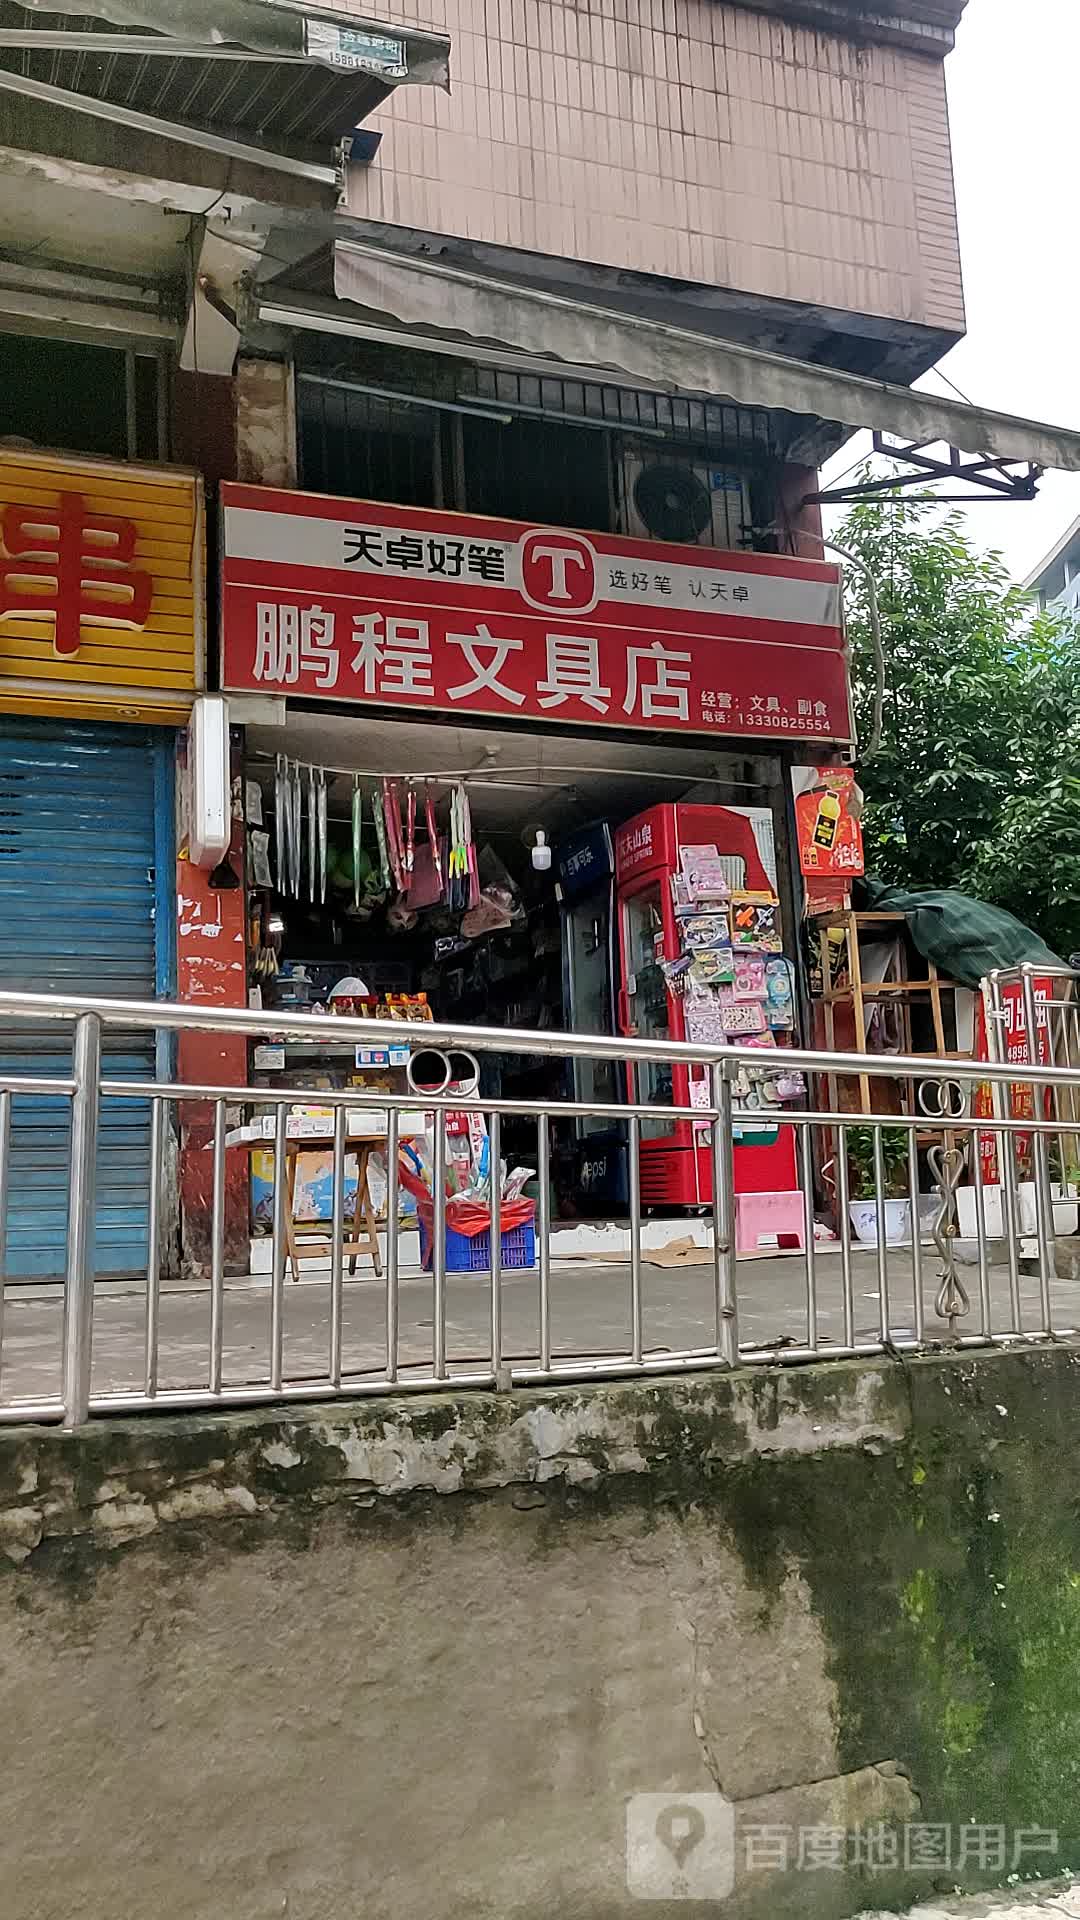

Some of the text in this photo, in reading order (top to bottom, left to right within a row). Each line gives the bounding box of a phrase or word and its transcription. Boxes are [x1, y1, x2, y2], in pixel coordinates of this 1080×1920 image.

[0, 492, 153, 657] 串
[343, 528, 505, 582] 天卓好笔
[531, 545, 585, 599] T
[609, 569, 749, 602] 选好笔 认天卓
[252, 602, 692, 720] 鹏程文具店
[580, 1156, 607, 1182] epsi
